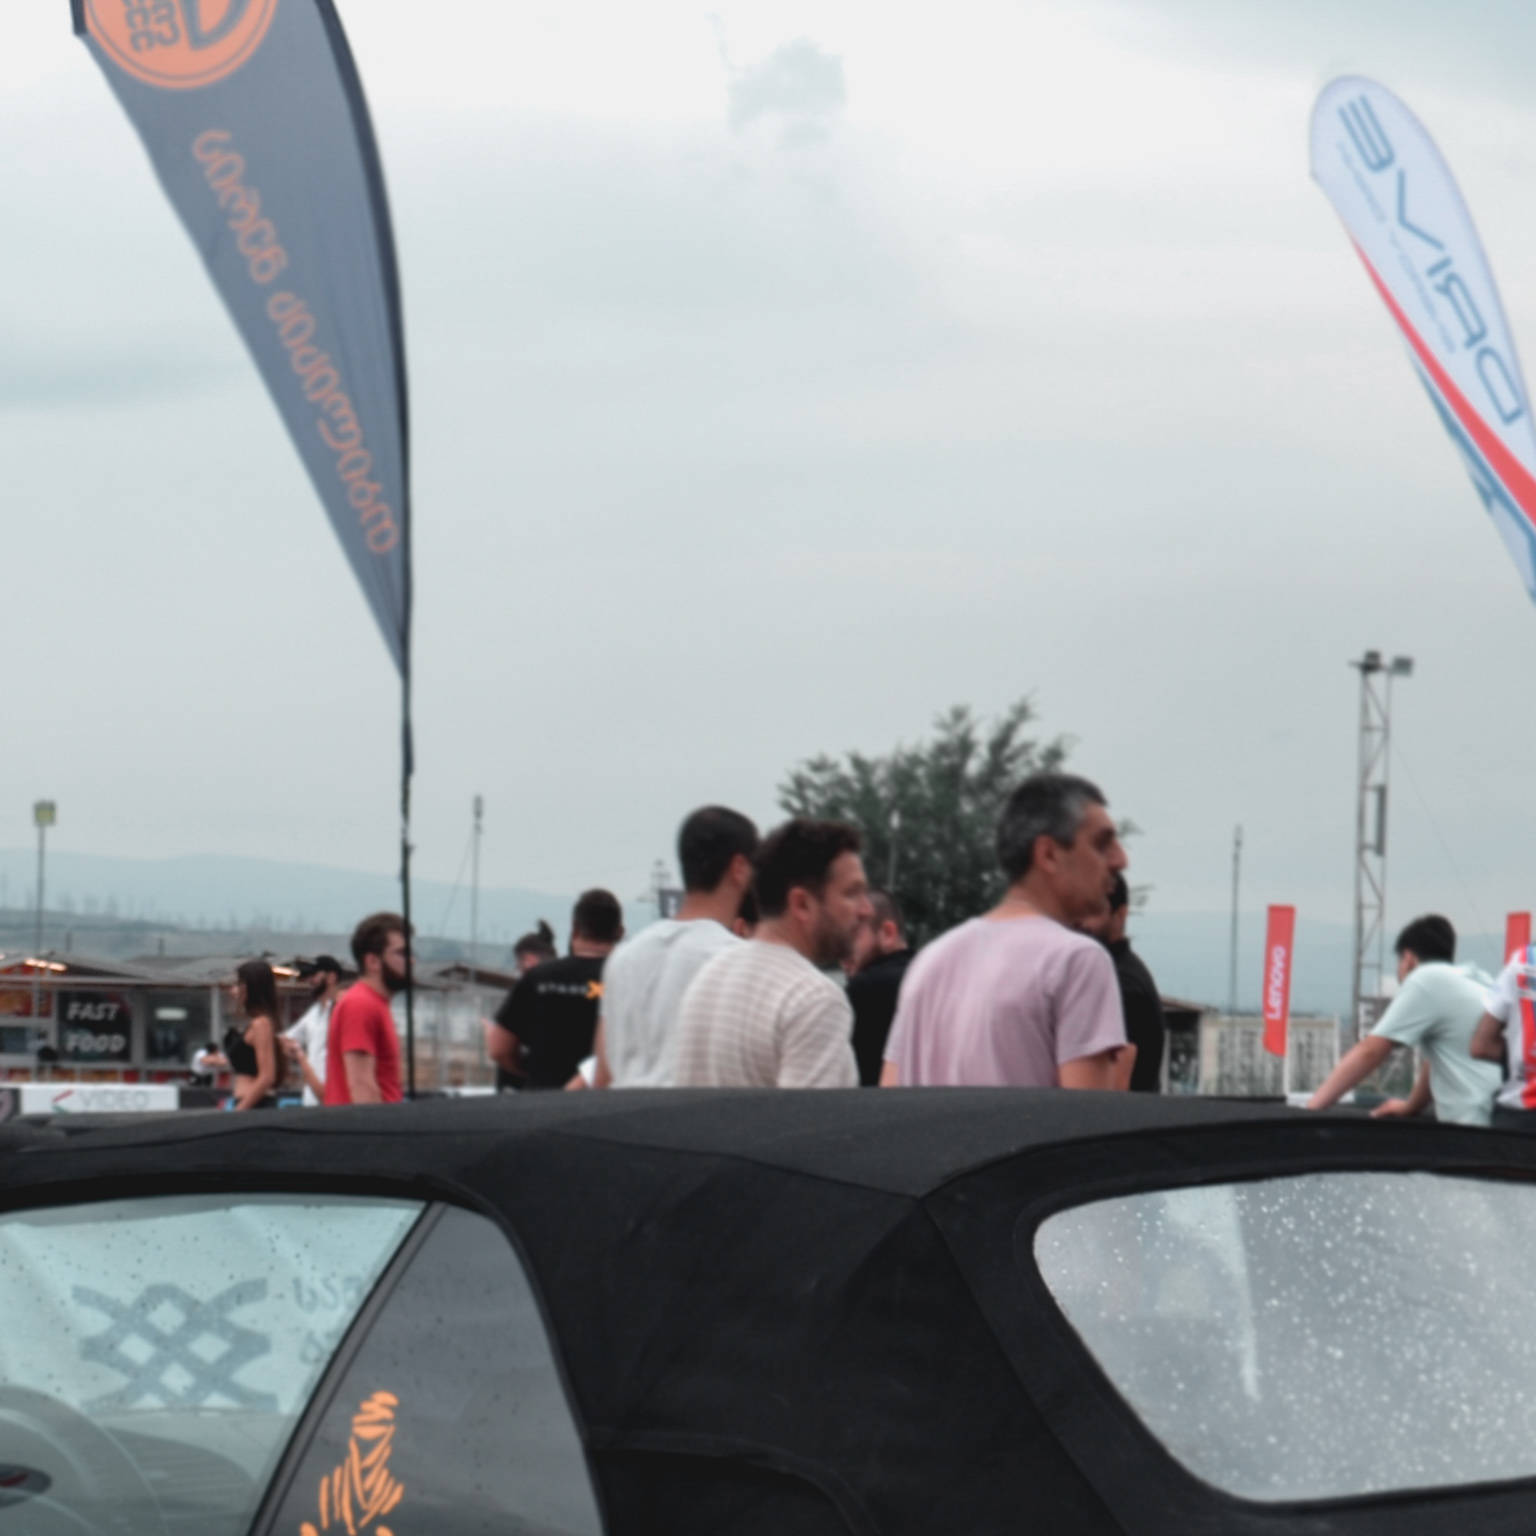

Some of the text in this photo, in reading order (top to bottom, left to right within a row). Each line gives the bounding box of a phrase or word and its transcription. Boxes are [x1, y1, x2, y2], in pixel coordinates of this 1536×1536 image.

[1266, 945, 1287, 1020] Lenovo
[67, 1001, 120, 1021] FAST
[66, 1033, 126, 1053] FOOD
